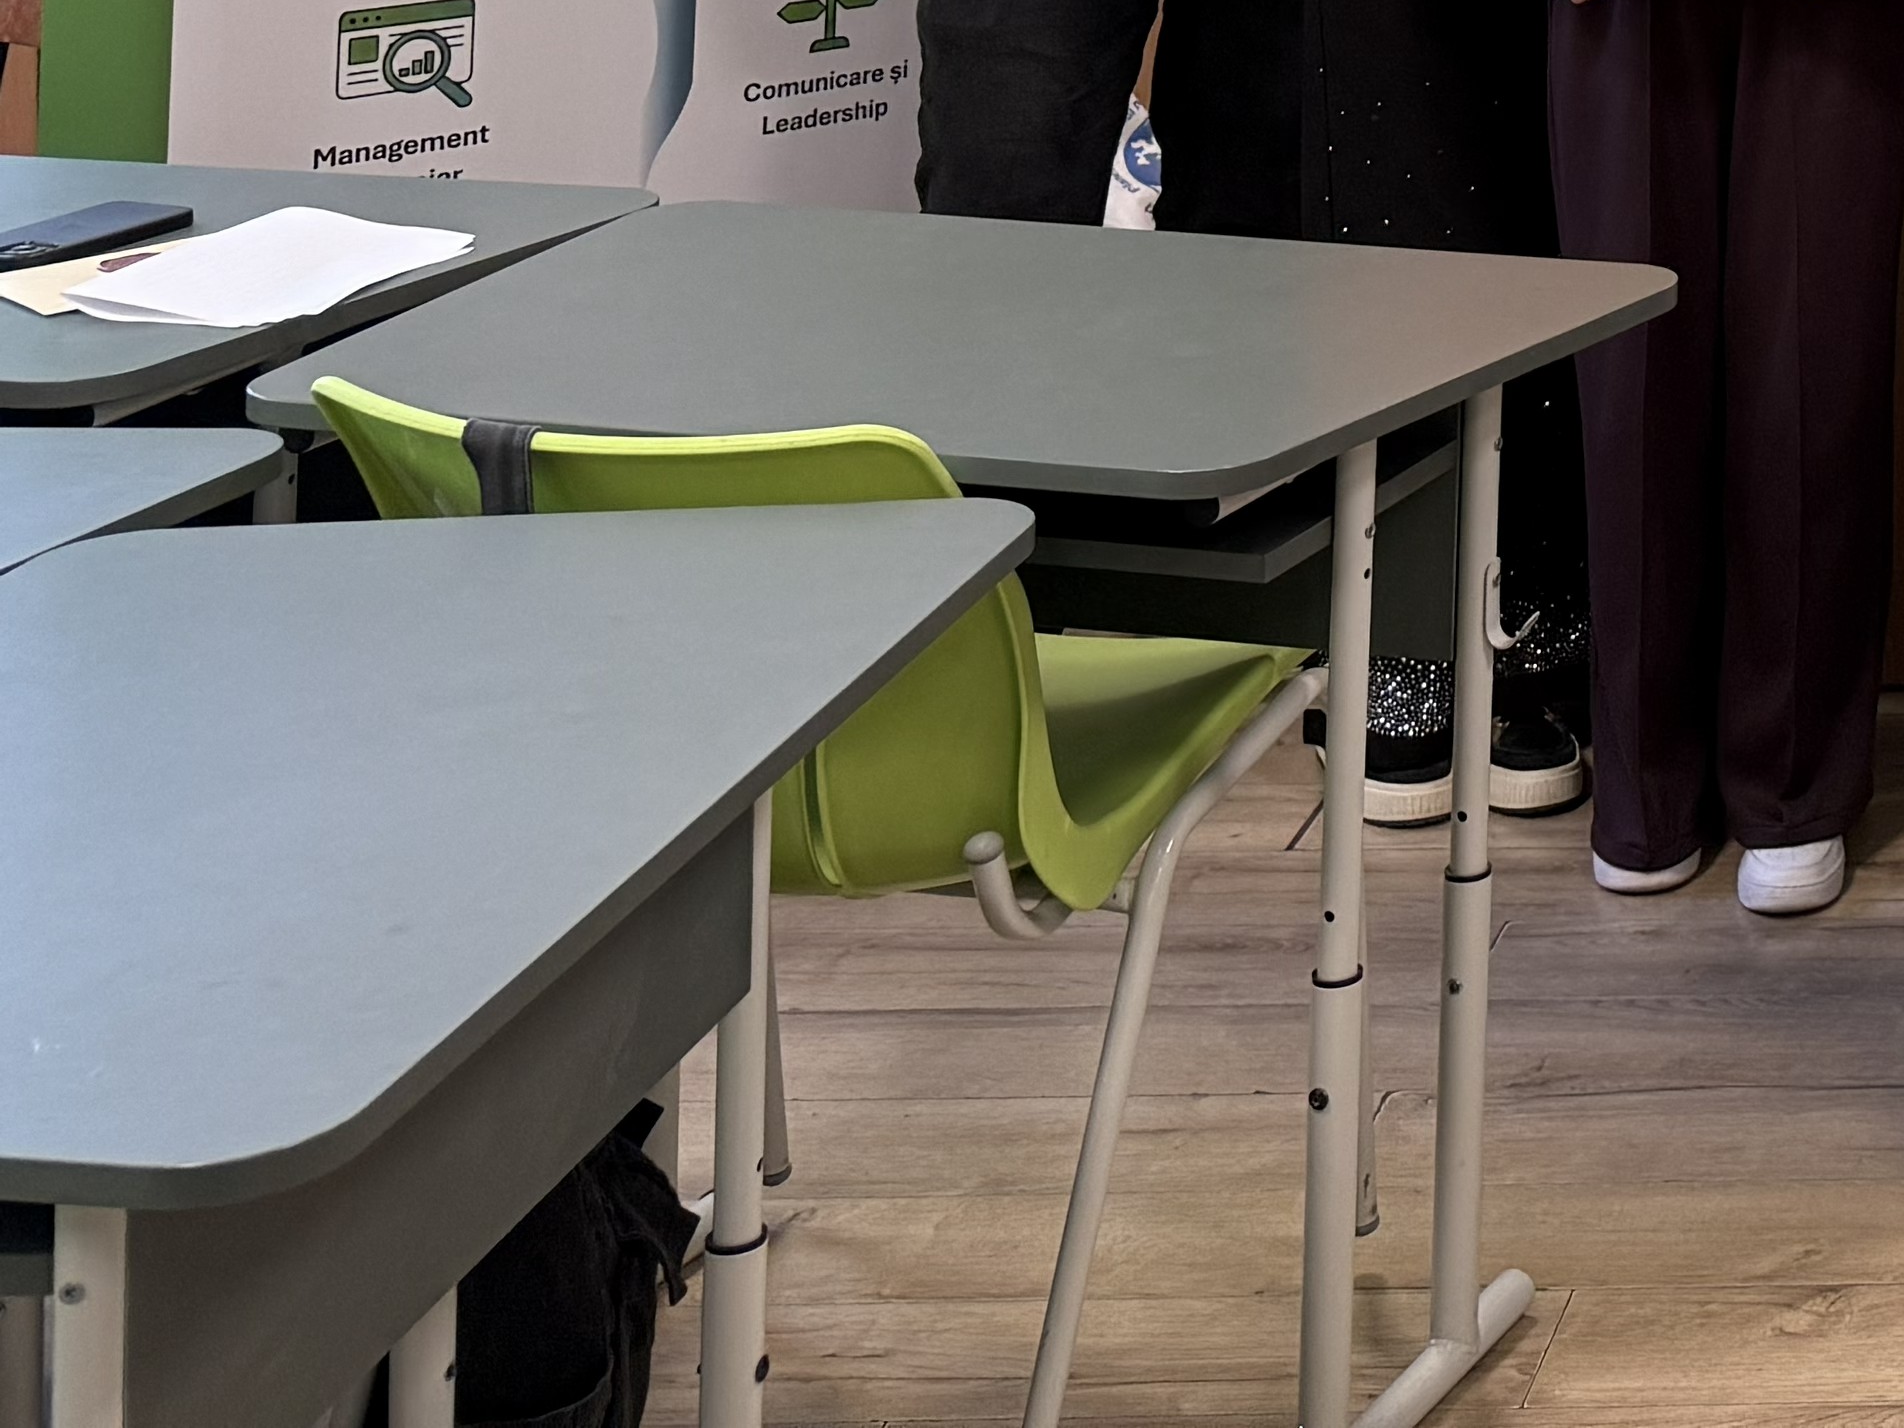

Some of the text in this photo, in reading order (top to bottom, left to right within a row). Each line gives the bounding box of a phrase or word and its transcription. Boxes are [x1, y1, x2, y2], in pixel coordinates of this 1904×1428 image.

[743, 59, 908, 102] Comunicare și
[762, 100, 888, 135] Leadership
[313, 125, 490, 170] Management
